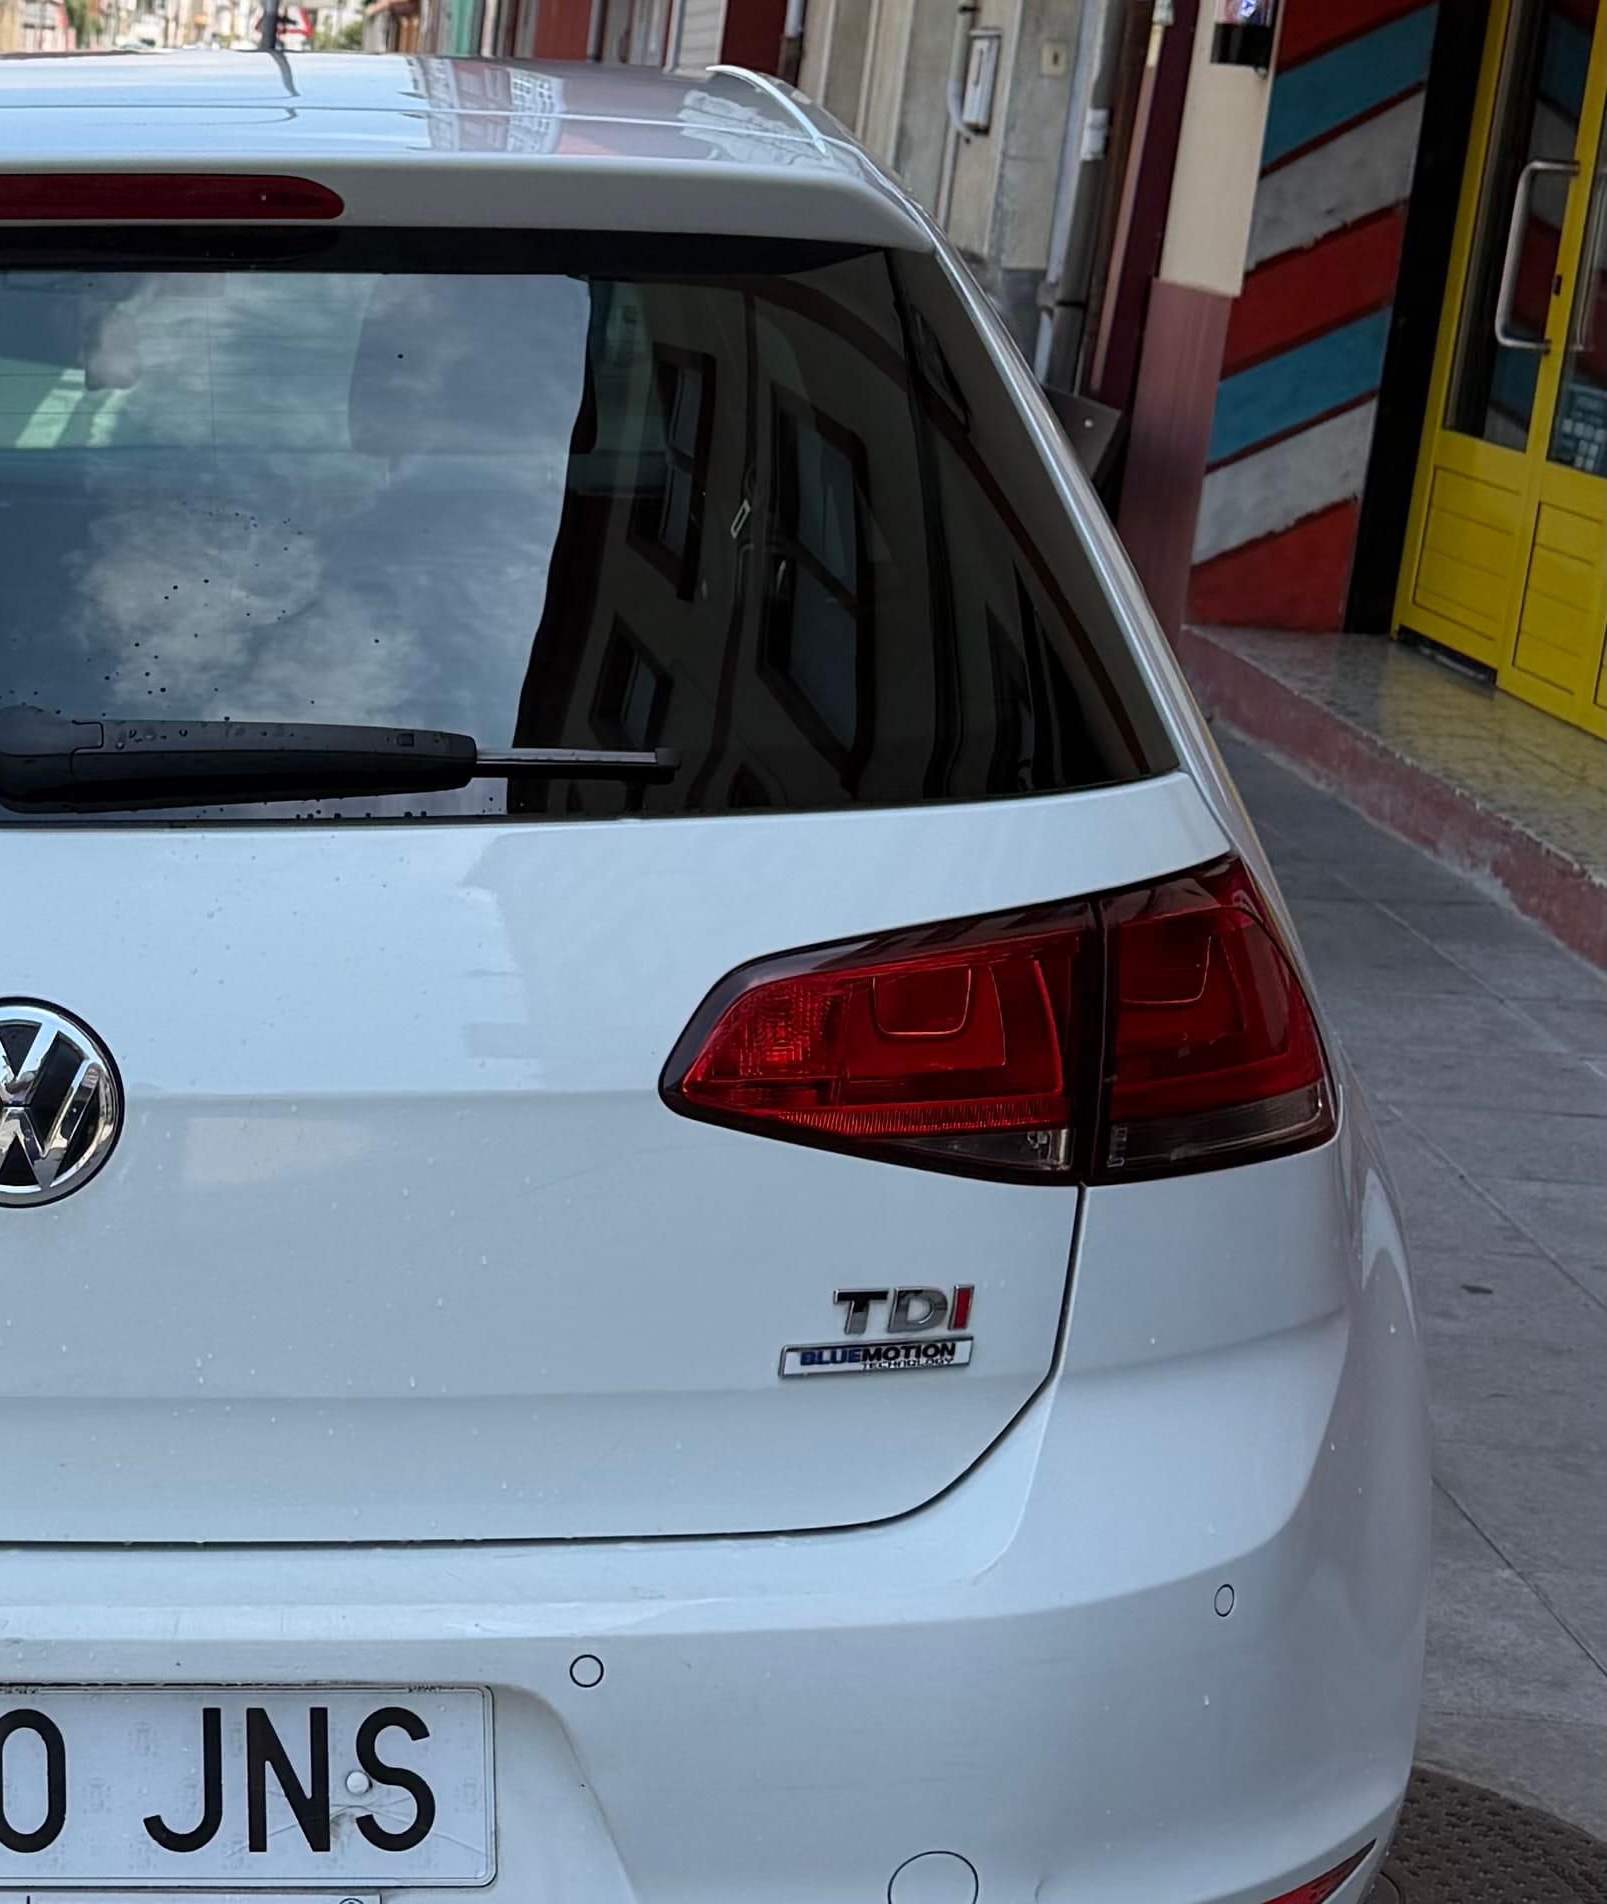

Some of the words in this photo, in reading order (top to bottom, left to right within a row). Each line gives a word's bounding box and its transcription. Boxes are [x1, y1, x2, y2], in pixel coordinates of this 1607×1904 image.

[832, 1283, 975, 1335] TDI
[800, 1342, 956, 1366] BLUEMOTION
[142, 1706, 437, 1853] JNS
